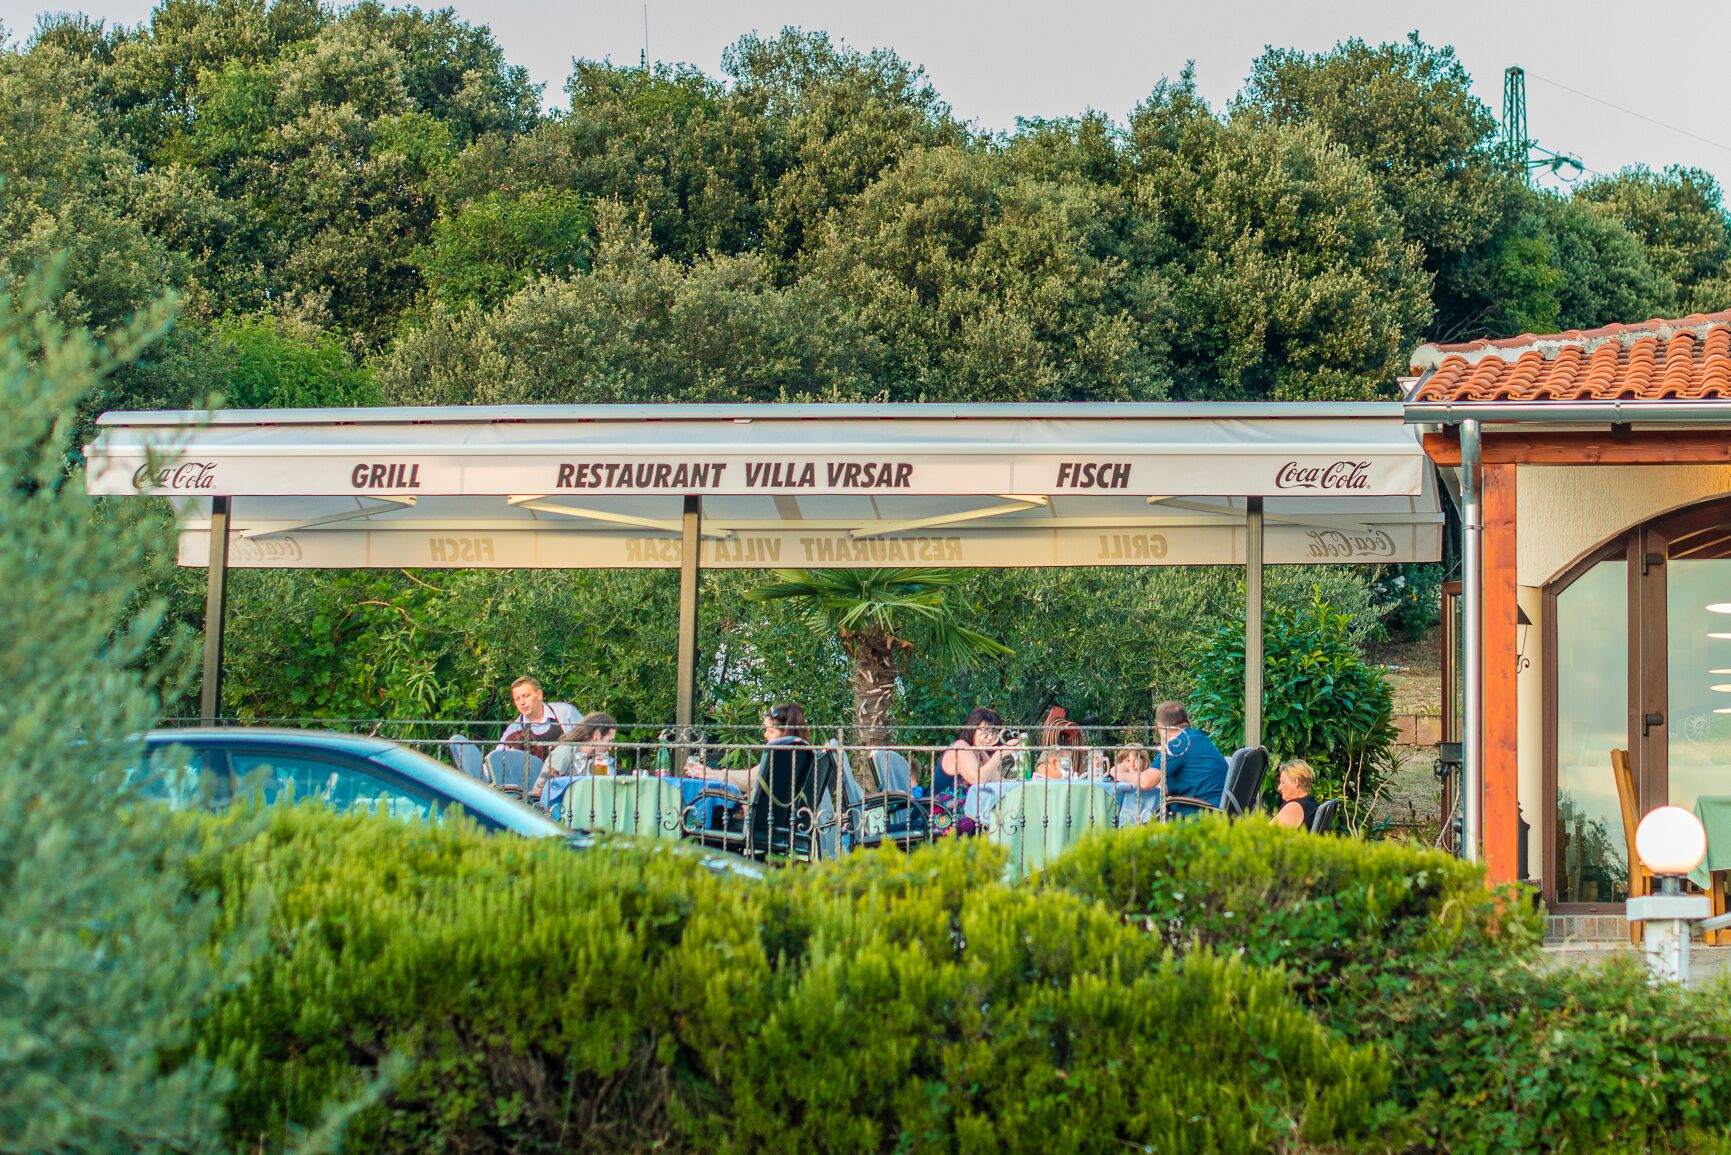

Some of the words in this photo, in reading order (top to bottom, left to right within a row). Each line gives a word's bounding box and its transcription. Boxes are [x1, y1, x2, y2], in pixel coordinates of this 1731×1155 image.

[132, 462, 217, 489] Coca-Cola
[351, 463, 421, 488] GRILL
[556, 462, 726, 488] RESTAURANT
[745, 462, 816, 488] VILLA
[827, 462, 914, 488] VRSAR
[1056, 462, 1132, 489] FISCH
[1275, 461, 1372, 489] Coca-Cola
